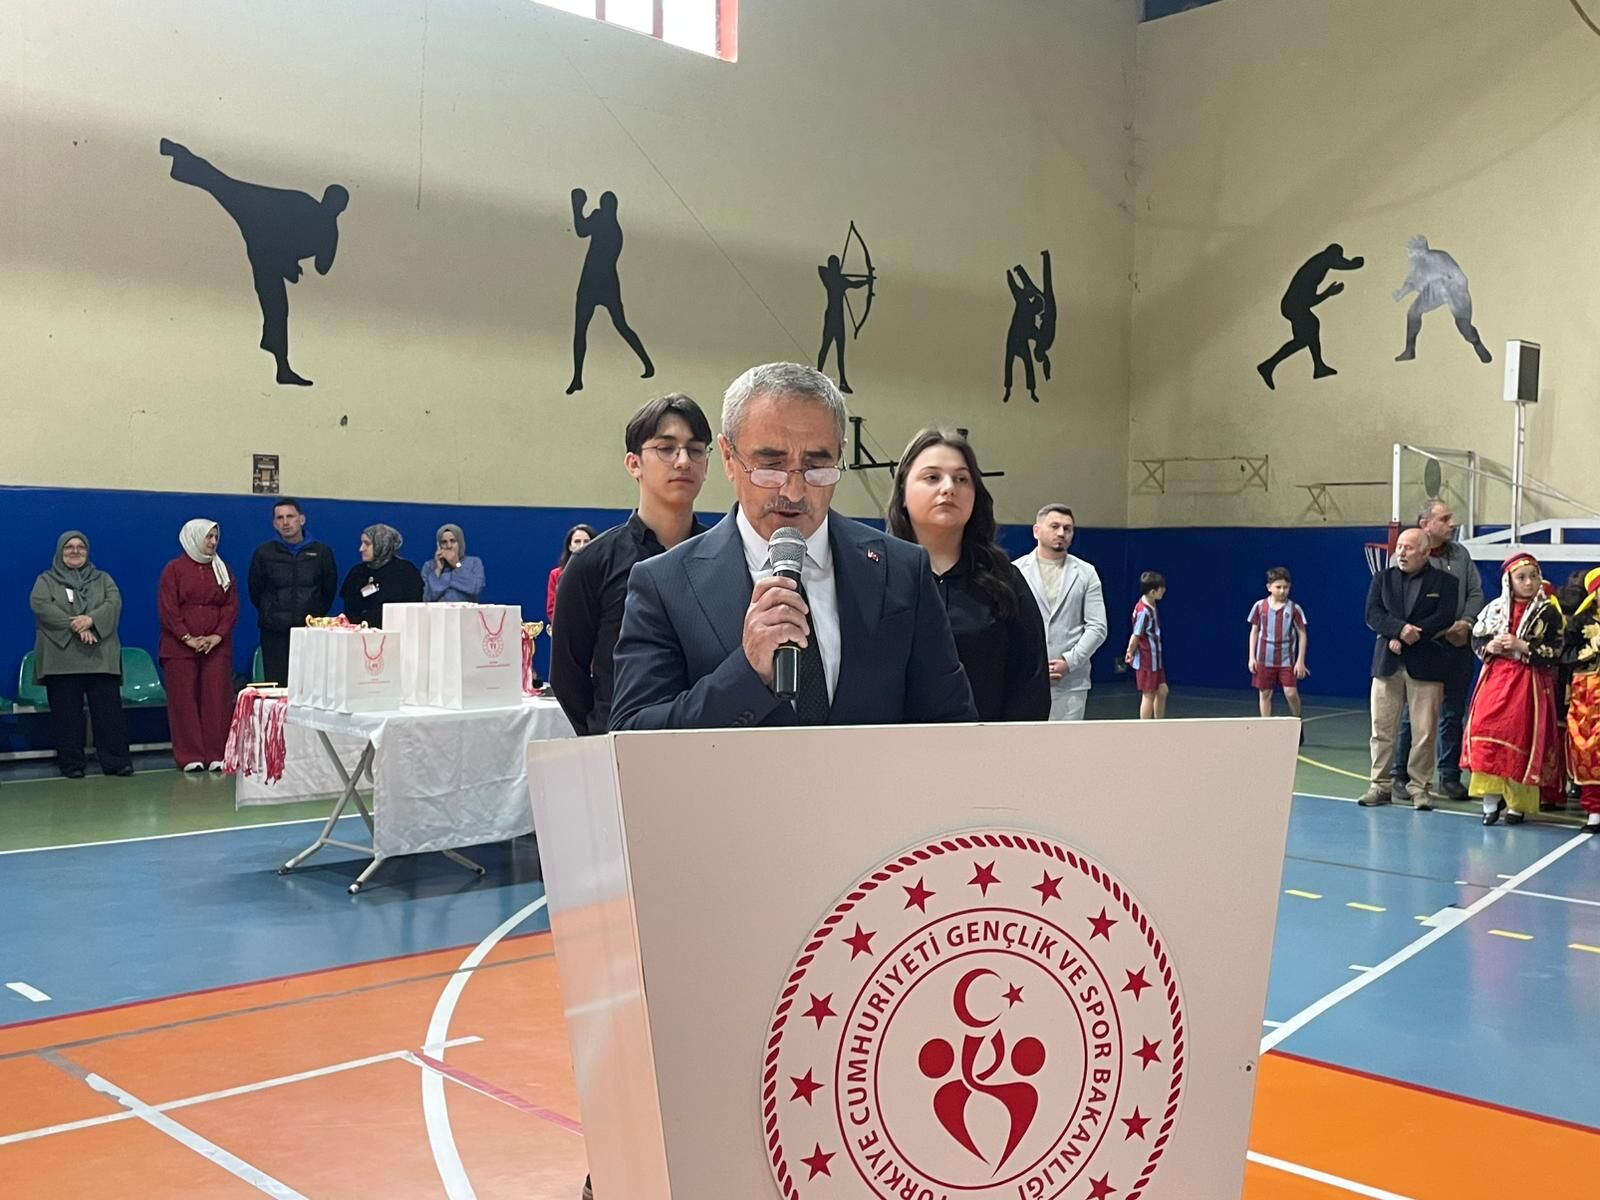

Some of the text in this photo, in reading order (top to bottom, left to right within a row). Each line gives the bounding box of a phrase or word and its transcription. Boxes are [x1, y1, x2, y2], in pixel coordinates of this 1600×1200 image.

[847, 920, 1112, 1200] RKİYE CUMHURİYETİ GENÇLİK VE SPOR BAKANLIĞI
